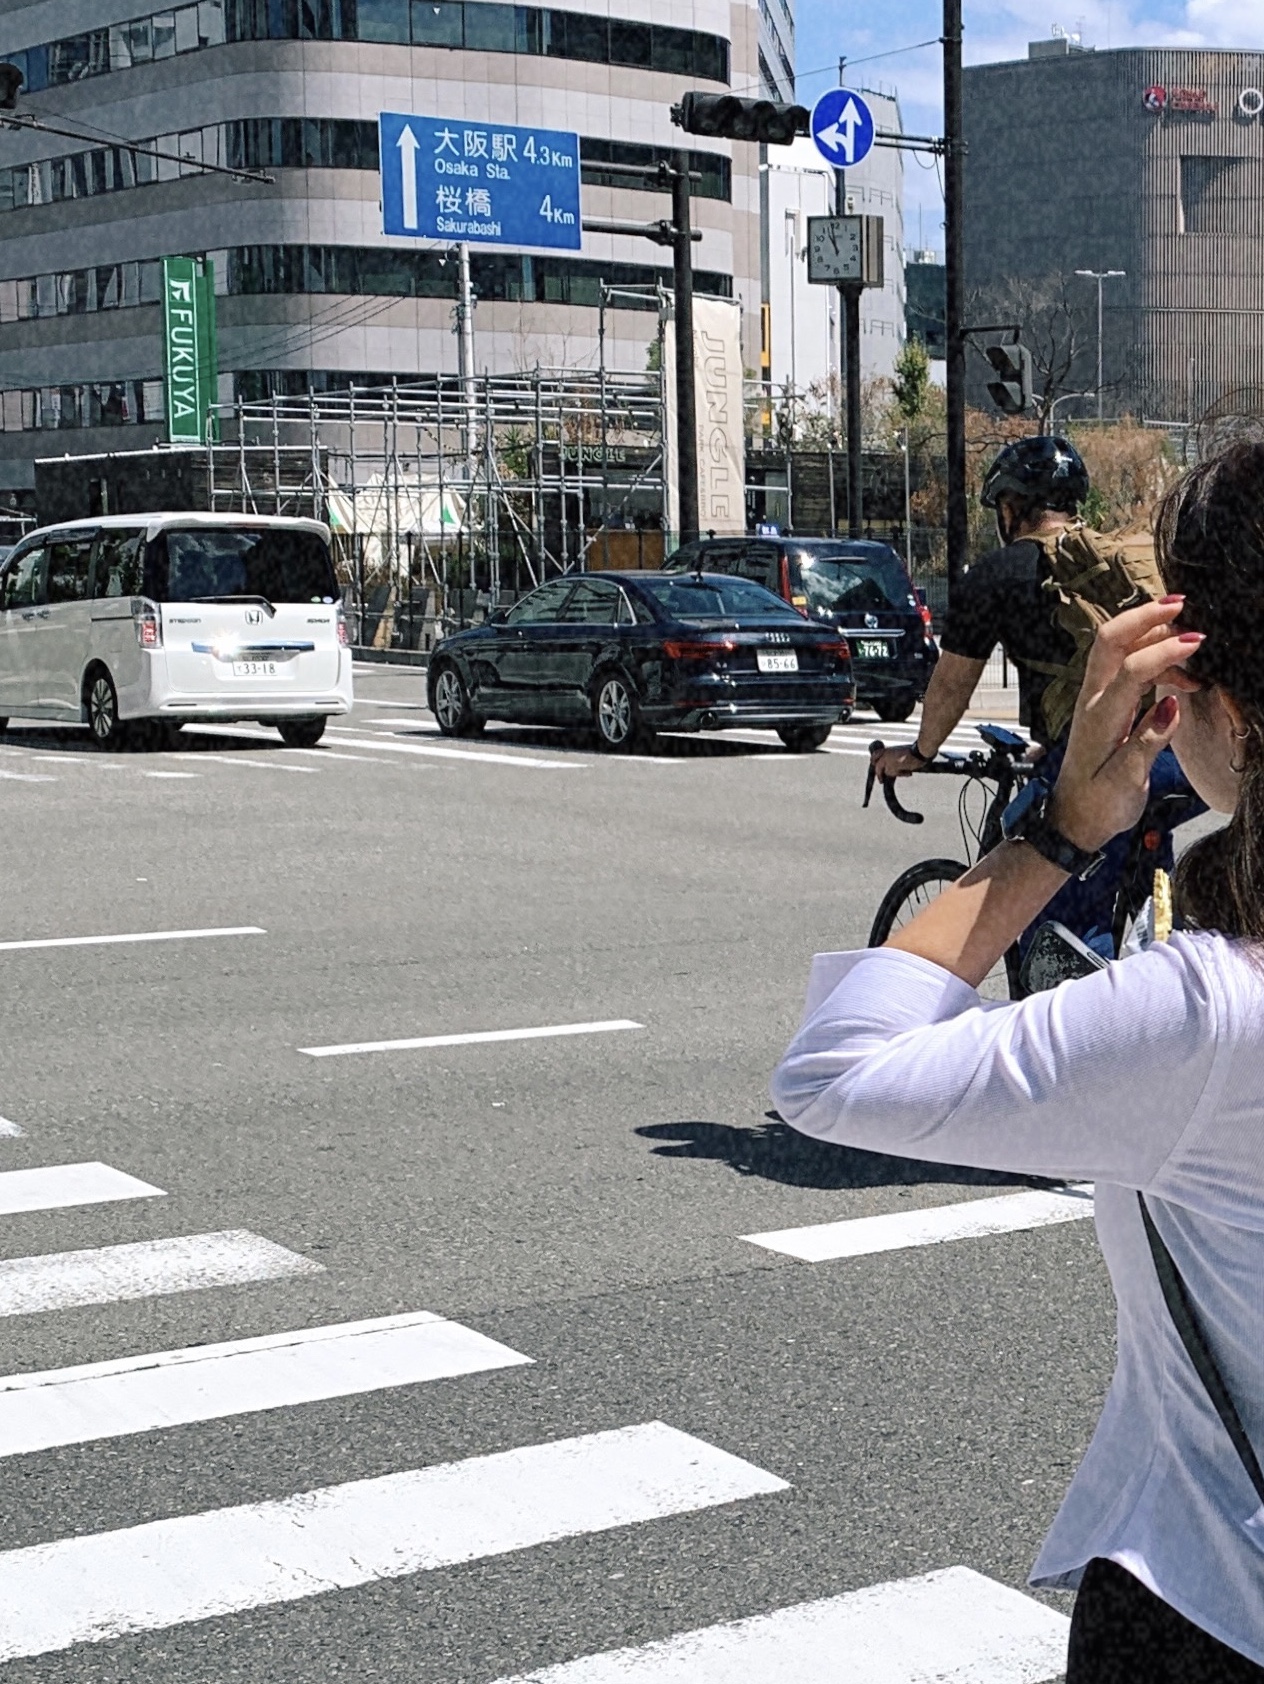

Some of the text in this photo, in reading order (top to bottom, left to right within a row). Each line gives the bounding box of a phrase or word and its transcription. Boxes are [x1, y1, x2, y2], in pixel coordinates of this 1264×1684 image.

[434, 127, 518, 162] 大阪駅
[434, 158, 479, 178] Osaka
[436, 184, 492, 218] 桜橋
[436, 216, 502, 237] Sakurabashi
[170, 308, 196, 419] FUKUYA
[700, 330, 730, 518] JUNGLE
[243, 662, 276, 675] 33-18
